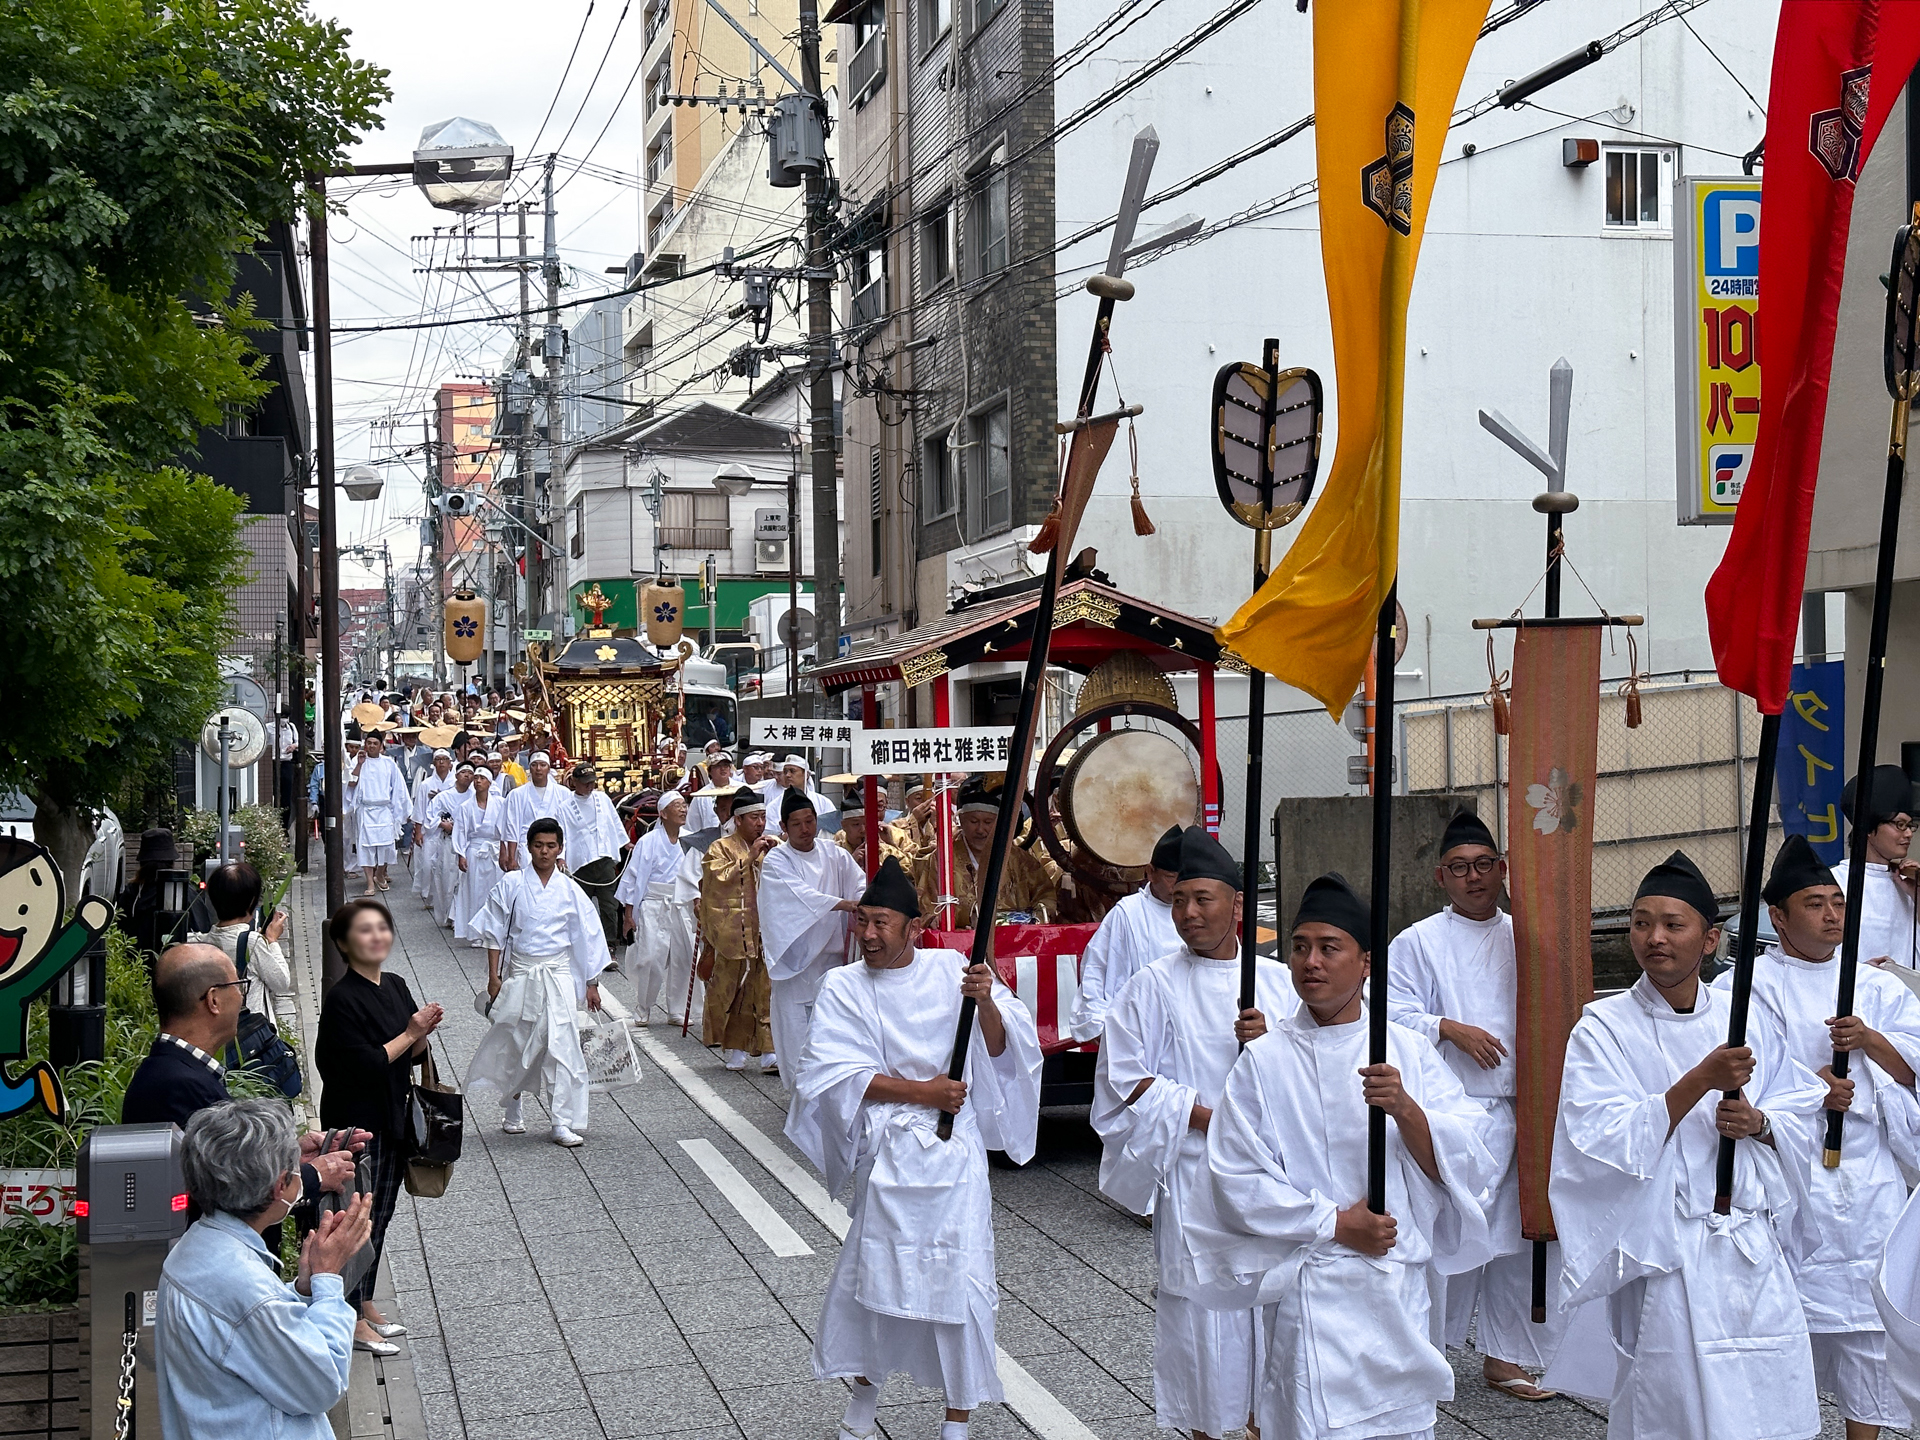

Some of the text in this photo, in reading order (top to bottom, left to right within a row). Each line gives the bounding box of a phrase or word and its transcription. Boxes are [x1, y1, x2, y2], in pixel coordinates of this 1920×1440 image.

[1719, 199, 1760, 269] P
[1703, 304, 1760, 372] 10
[763, 724, 851, 742] 大神宮神輿
[870, 735, 1011, 765] 櫛田神社雅楽部
